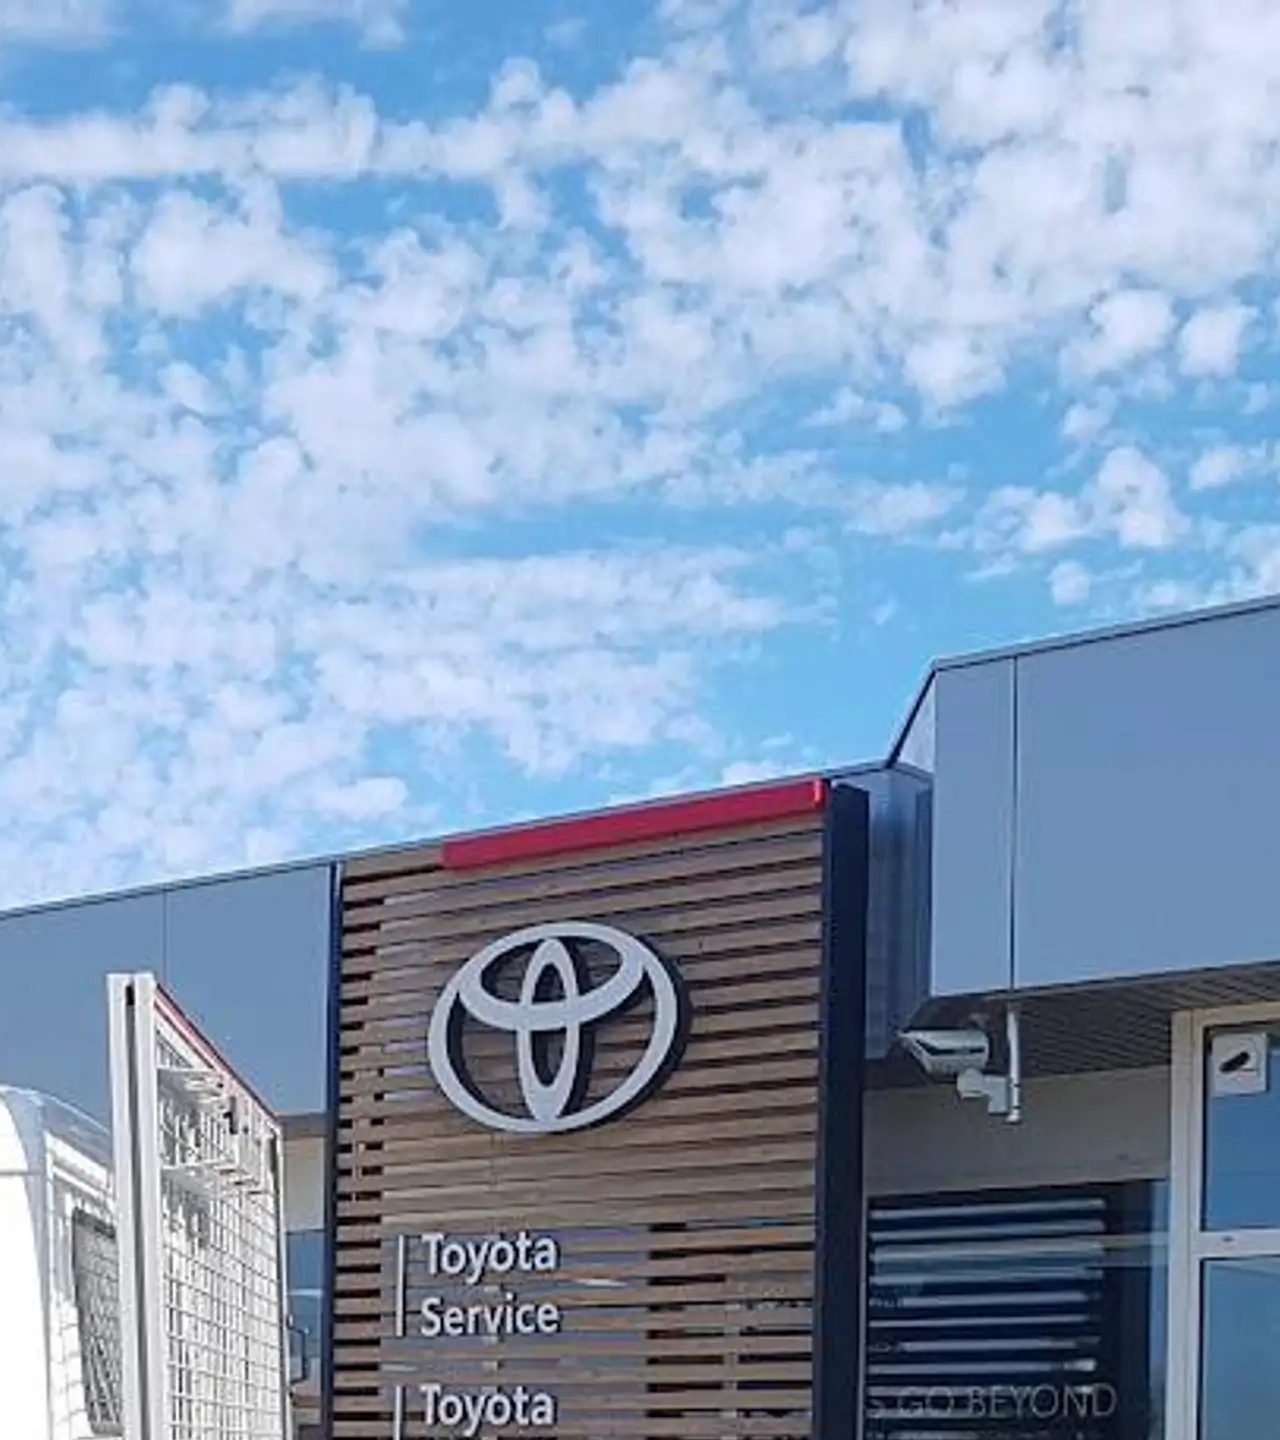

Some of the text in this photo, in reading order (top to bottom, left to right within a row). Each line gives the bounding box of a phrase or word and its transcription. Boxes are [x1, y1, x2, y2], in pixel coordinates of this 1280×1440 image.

[421, 1231, 557, 1284] Toyota
[420, 1292, 559, 1336] Service
[420, 1383, 555, 1437] Toyota
[897, 1385, 955, 1417] GO
[968, 1382, 1119, 1418] BEYOND
